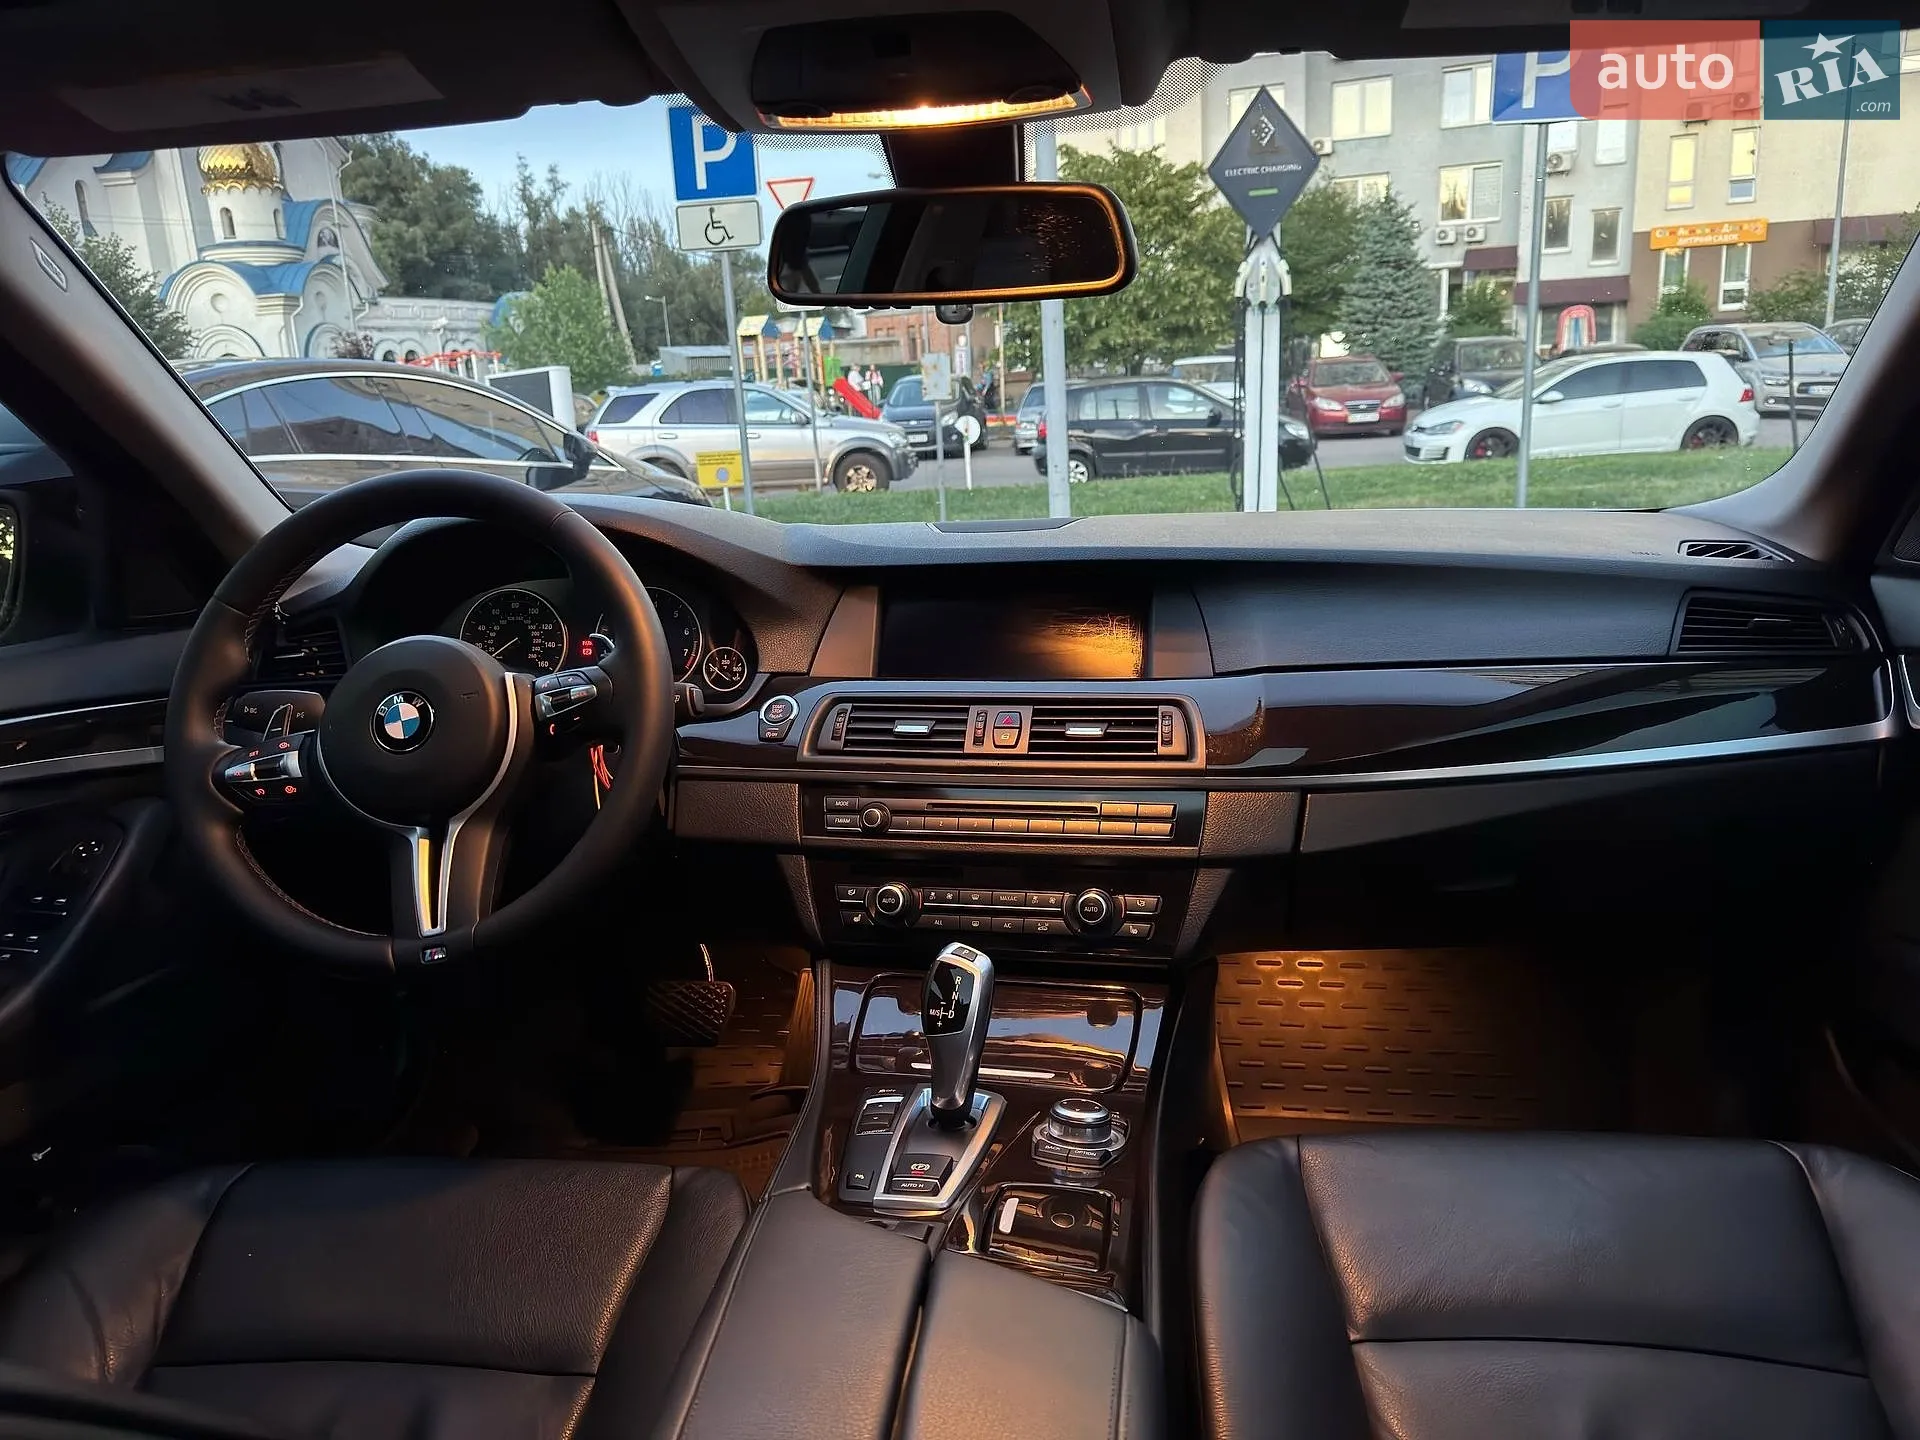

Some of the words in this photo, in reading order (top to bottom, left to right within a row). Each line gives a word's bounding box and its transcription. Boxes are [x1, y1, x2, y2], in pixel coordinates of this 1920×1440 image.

[1522, 51, 1582, 109] P
[691, 112, 737, 191] P
[1224, 166, 1260, 177] ELECTRIC
[1260, 163, 1302, 174] CHARGING
[378, 694, 425, 717] BMW
[955, 975, 962, 985] R
[951, 991, 959, 1000] N
[929, 1008, 940, 1017] M/S
[947, 1009, 955, 1019] D
[1074, 1149, 1097, 1157] OPTION
